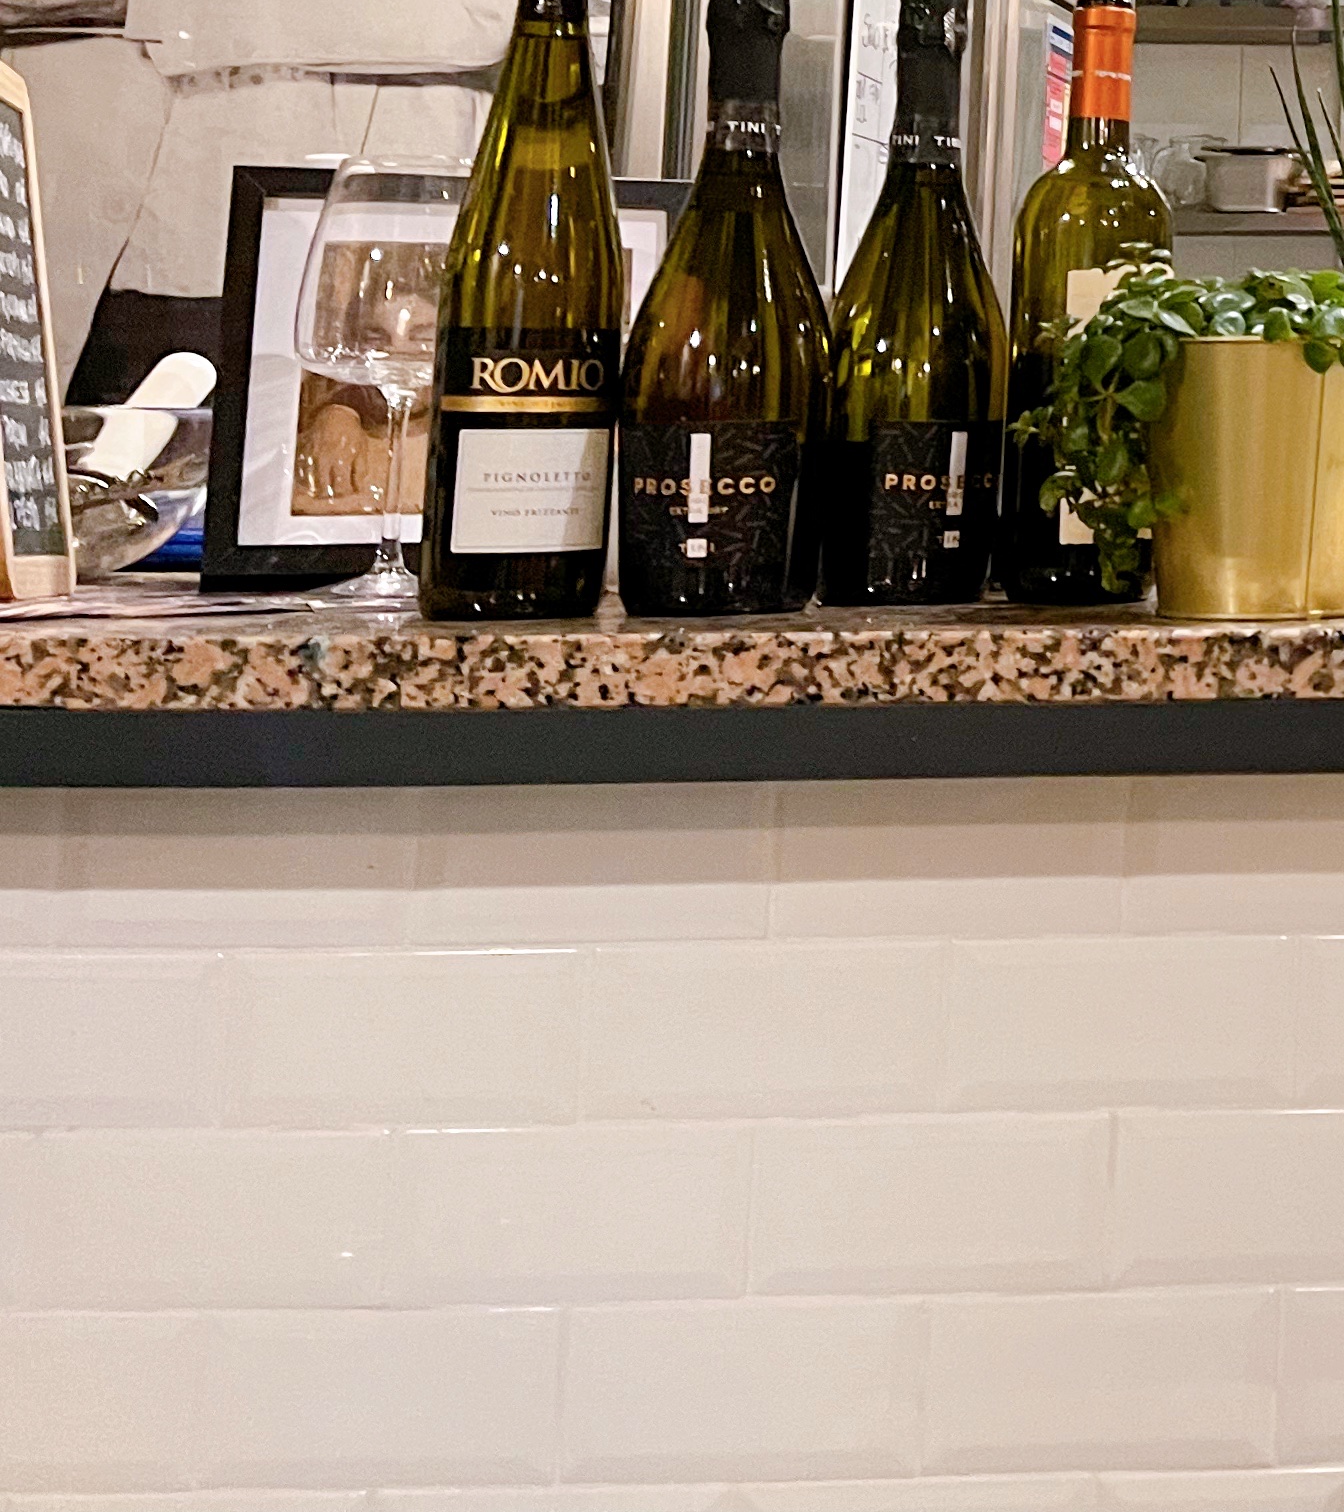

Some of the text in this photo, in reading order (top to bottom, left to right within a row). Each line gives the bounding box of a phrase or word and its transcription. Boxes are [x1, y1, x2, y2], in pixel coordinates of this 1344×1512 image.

[727, 120, 765, 134] TINI
[470, 357, 605, 394] ROMIO
[483, 471, 592, 484] PIGNOLETTO
[633, 476, 776, 496] PROSECCO
